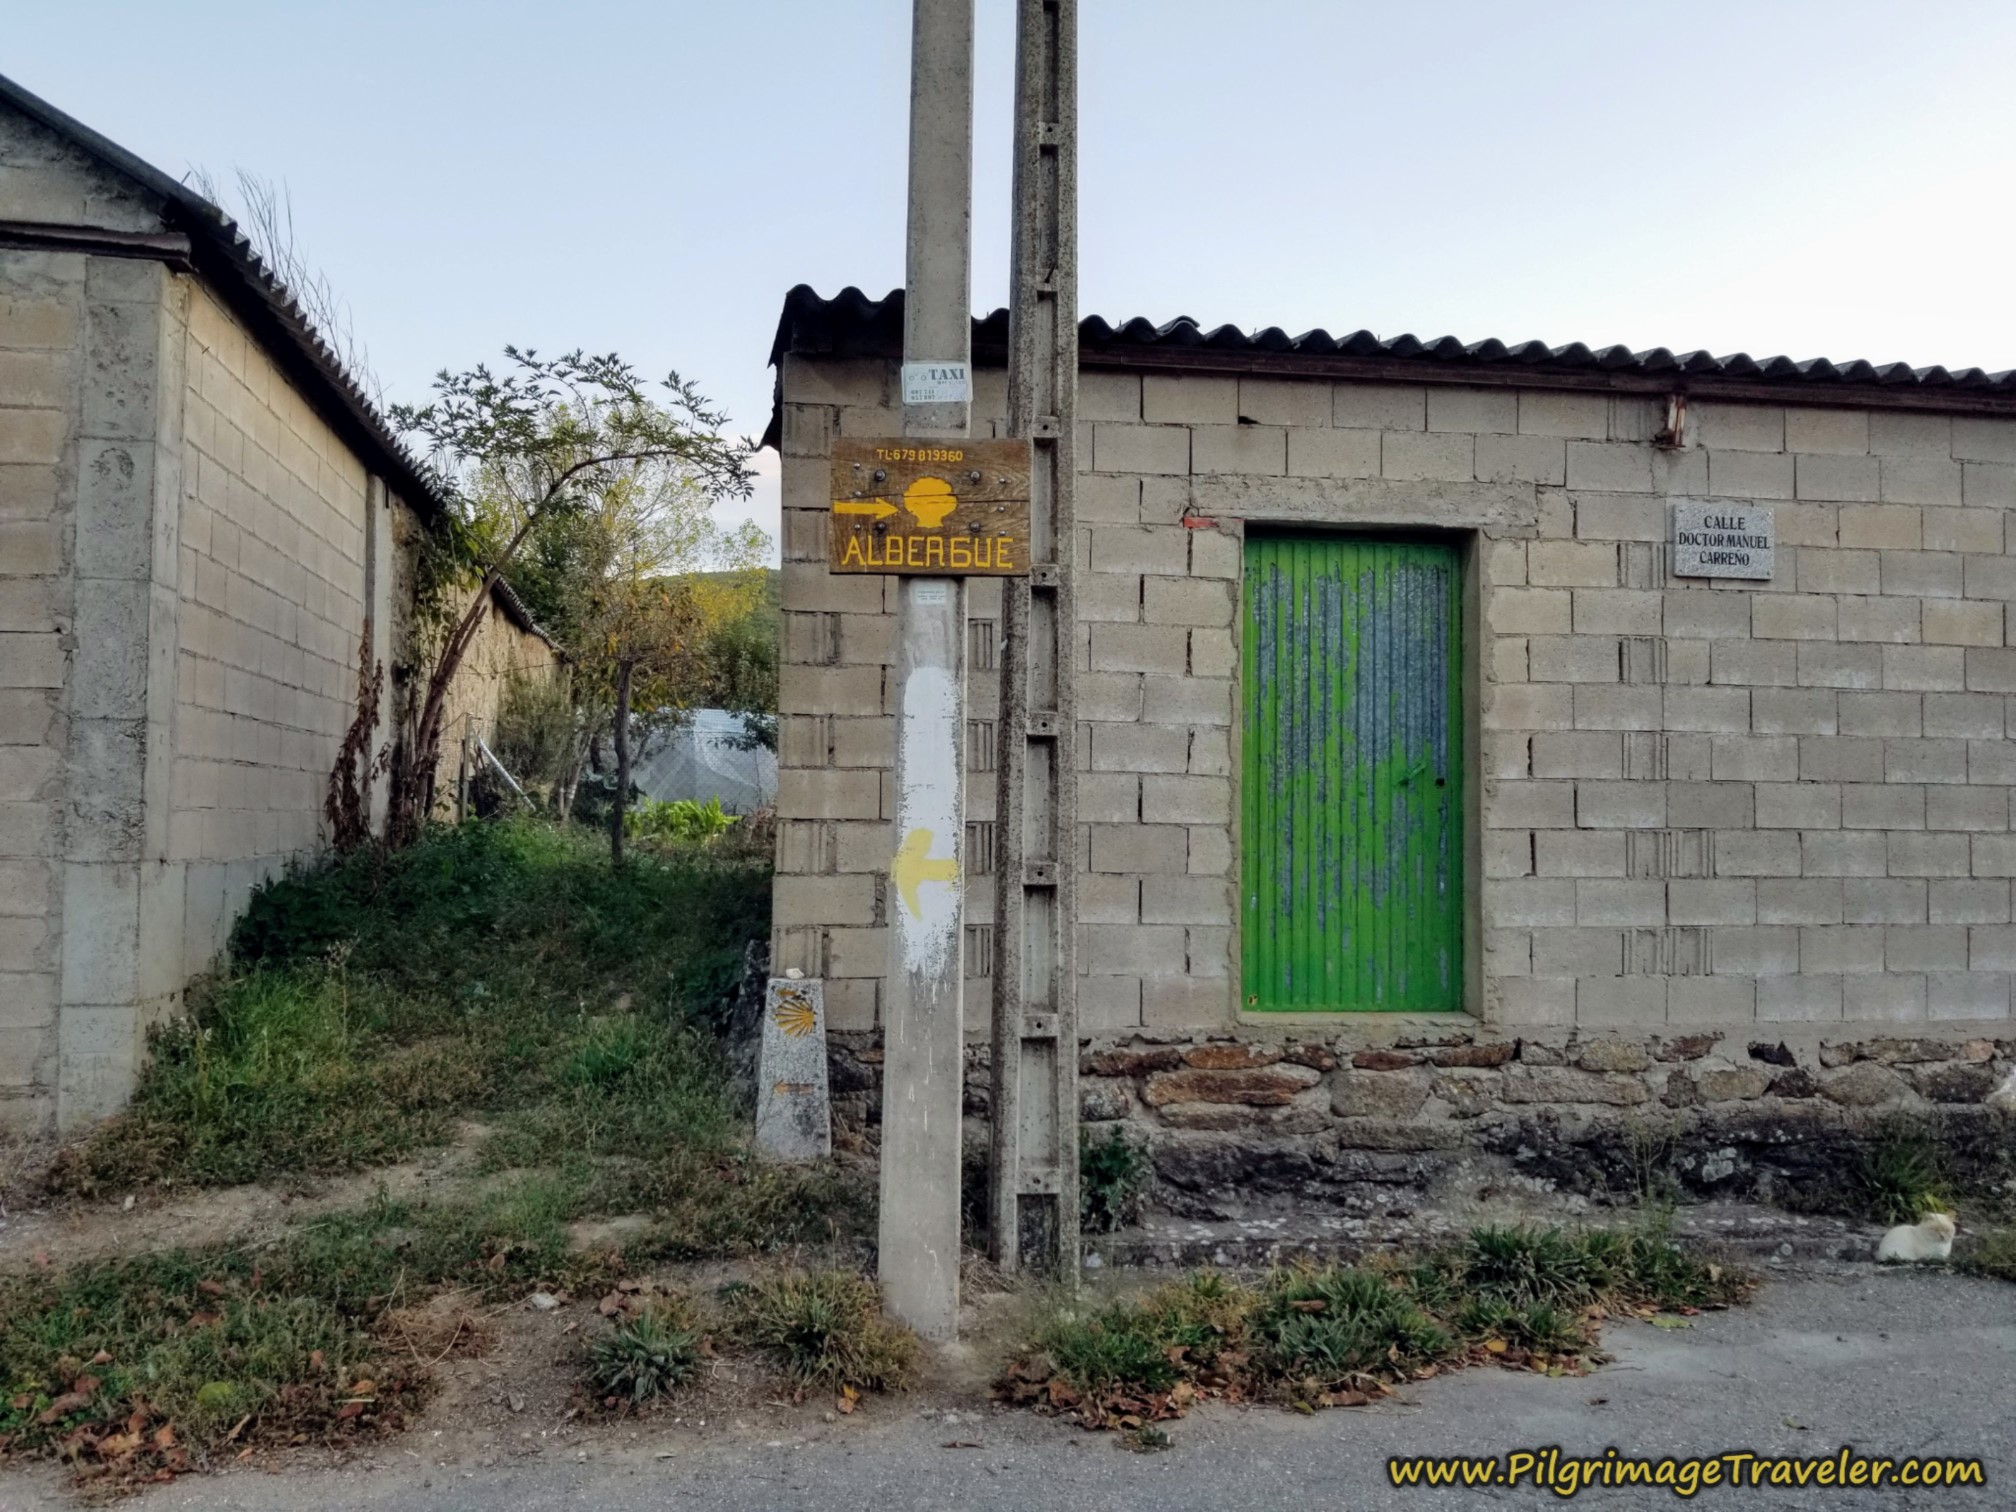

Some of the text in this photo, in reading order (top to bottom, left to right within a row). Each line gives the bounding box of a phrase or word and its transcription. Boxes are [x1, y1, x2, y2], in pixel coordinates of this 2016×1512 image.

[928, 368, 964, 380] TAXI
[1704, 515, 1746, 530] CALLE
[1679, 532, 1770, 549] DOCTOR MANUEL
[1700, 549, 1750, 566] CARREÑO
